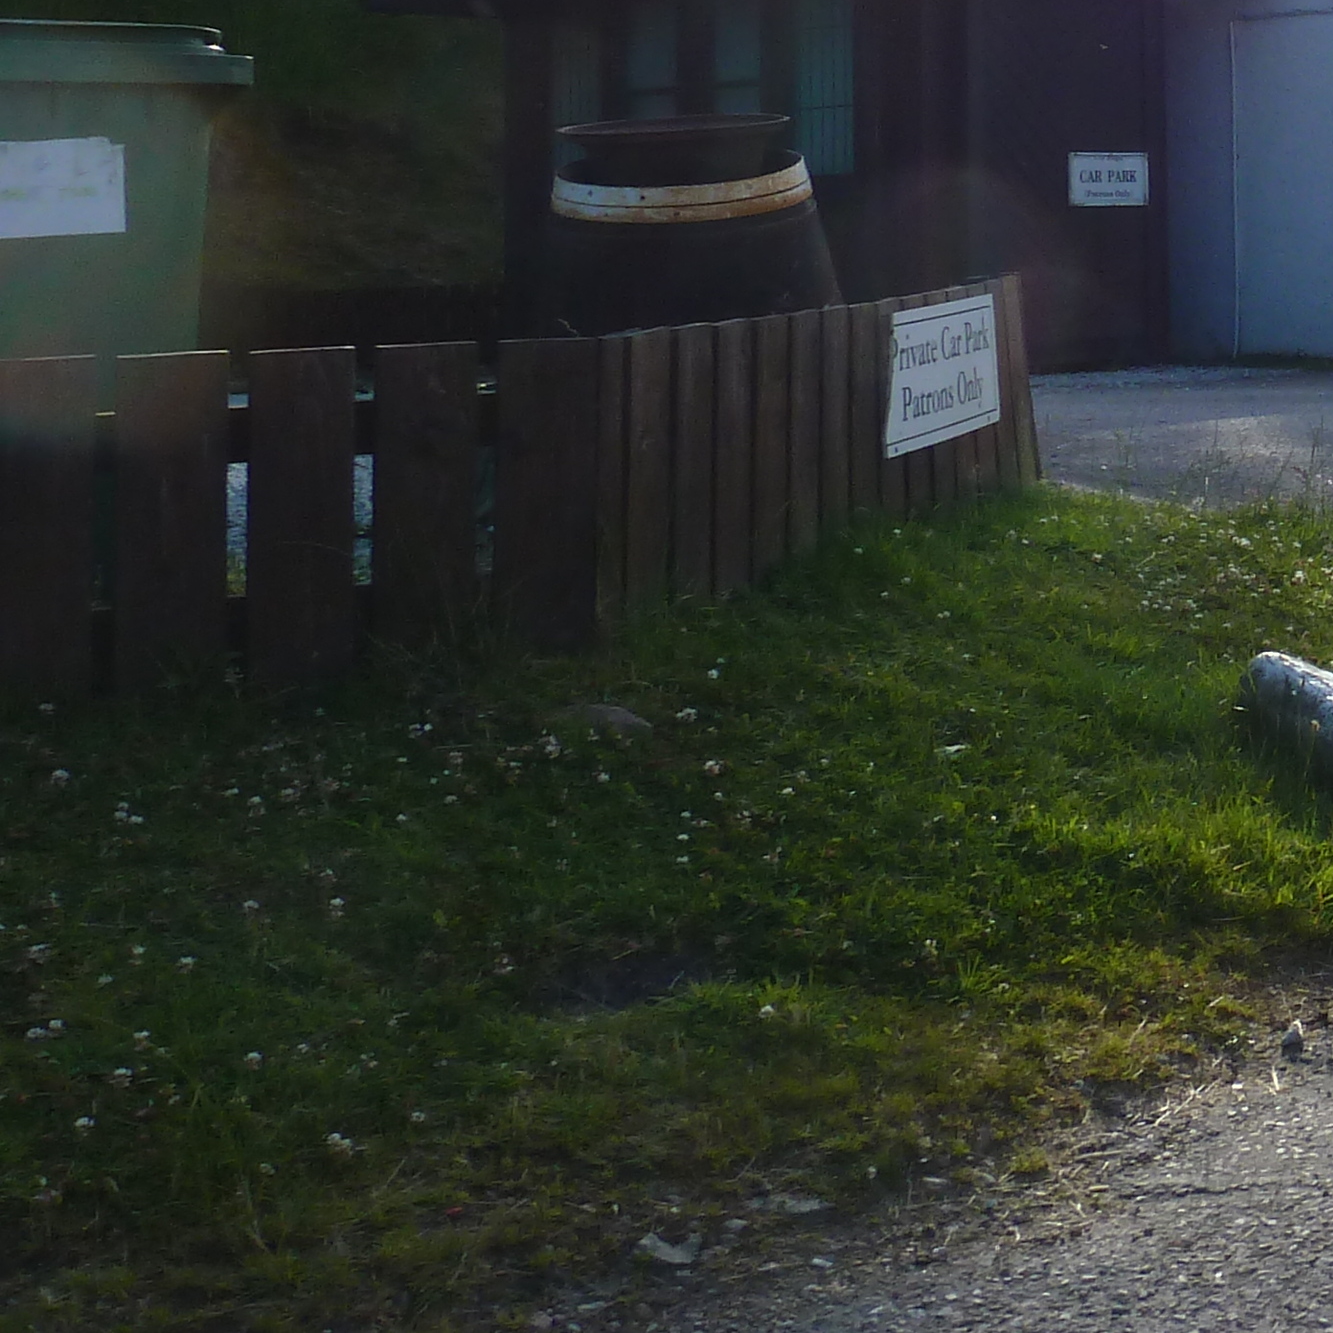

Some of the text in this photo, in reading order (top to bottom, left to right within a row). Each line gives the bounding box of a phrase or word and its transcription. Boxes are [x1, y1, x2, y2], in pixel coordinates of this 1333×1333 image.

[1079, 169, 1137, 184] CAR PARK
[891, 313, 990, 373] Private Car Park
[902, 366, 984, 422] Patrons Only
